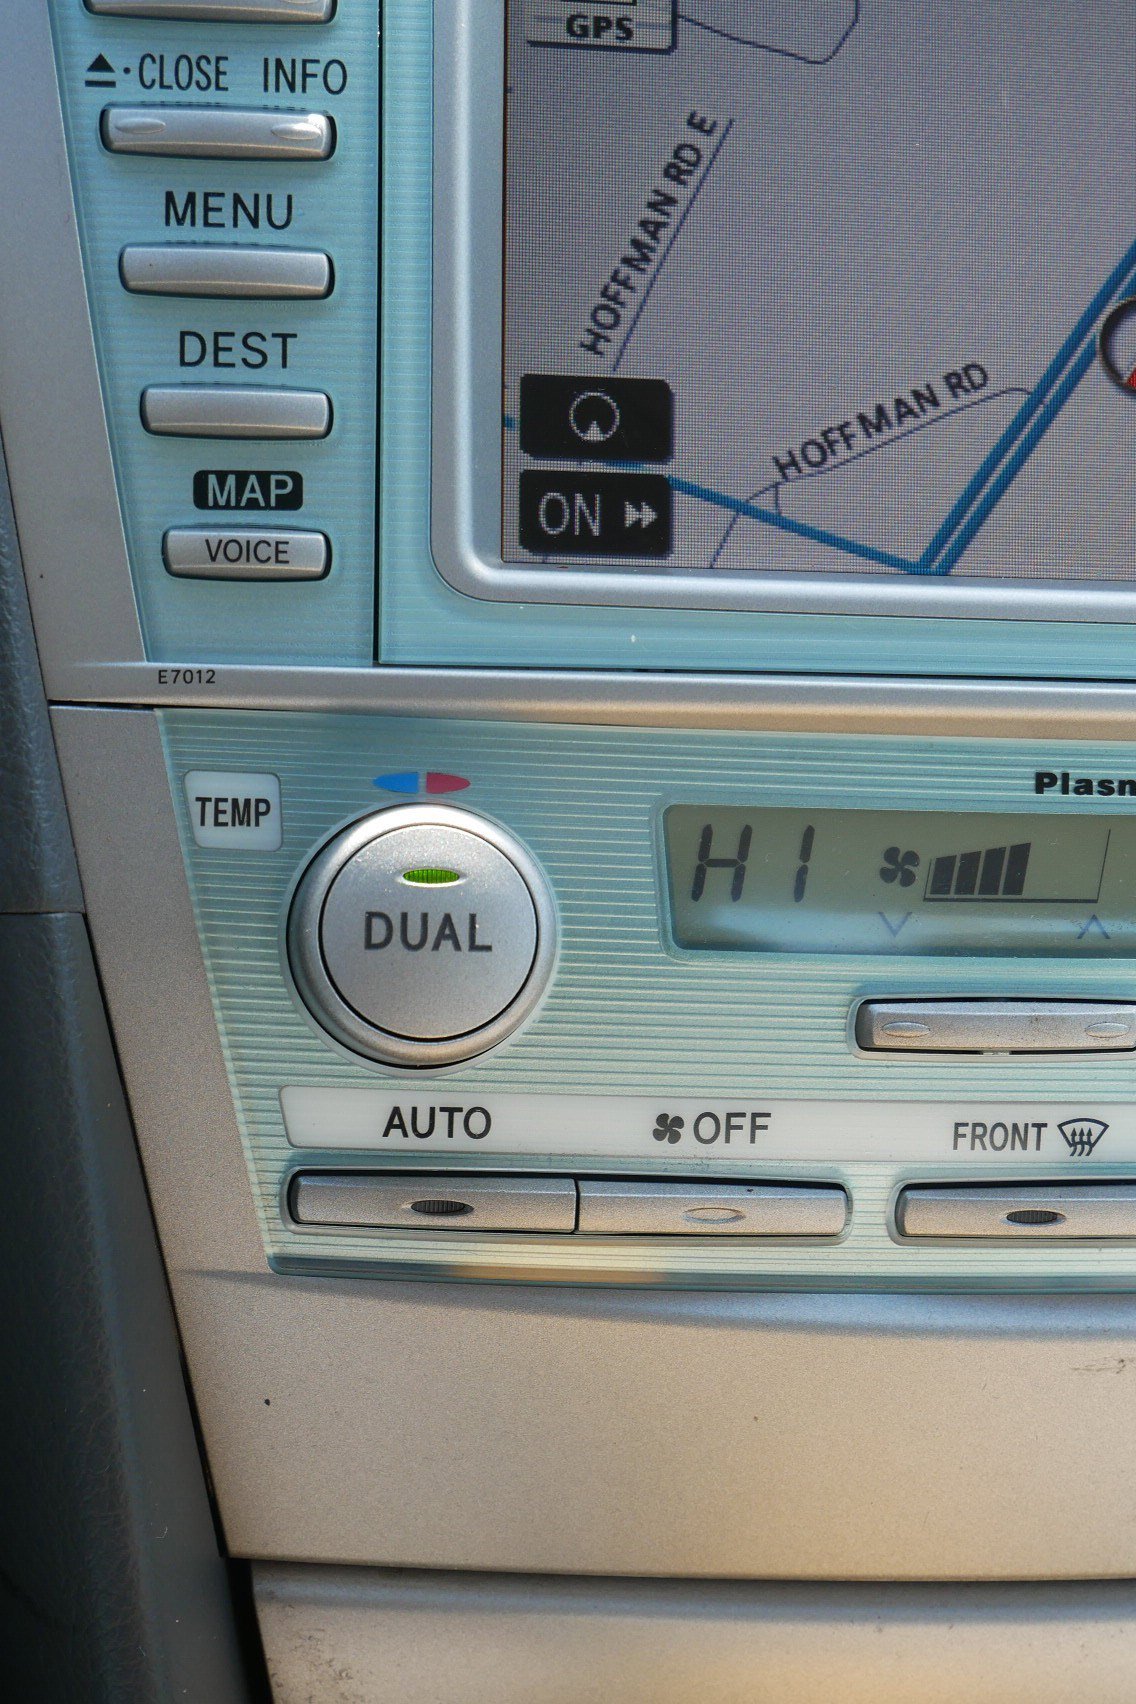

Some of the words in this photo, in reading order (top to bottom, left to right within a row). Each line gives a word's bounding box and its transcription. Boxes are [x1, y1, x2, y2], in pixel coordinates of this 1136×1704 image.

[565, 14, 634, 41] GPS
[138, 54, 229, 91] CLOSE
[263, 58, 348, 95] INFO
[164, 190, 294, 230] MENU
[579, 188, 682, 356] HOFFMAN
[663, 141, 704, 187] RD
[686, 110, 718, 138] E
[179, 330, 298, 369] DEST
[772, 380, 940, 482] HOFFMAN
[943, 362, 990, 408] RD
[206, 474, 295, 507] MAP
[538, 493, 601, 536] ON
[204, 539, 291, 565] VOICE
[157, 669, 216, 685] E7012
[195, 797, 272, 828] TEMP
[364, 911, 493, 953] DUAL
[382, 1106, 493, 1140] AUTO
[692, 1112, 771, 1145] OFF
[953, 1121, 1048, 1151] FRONT
